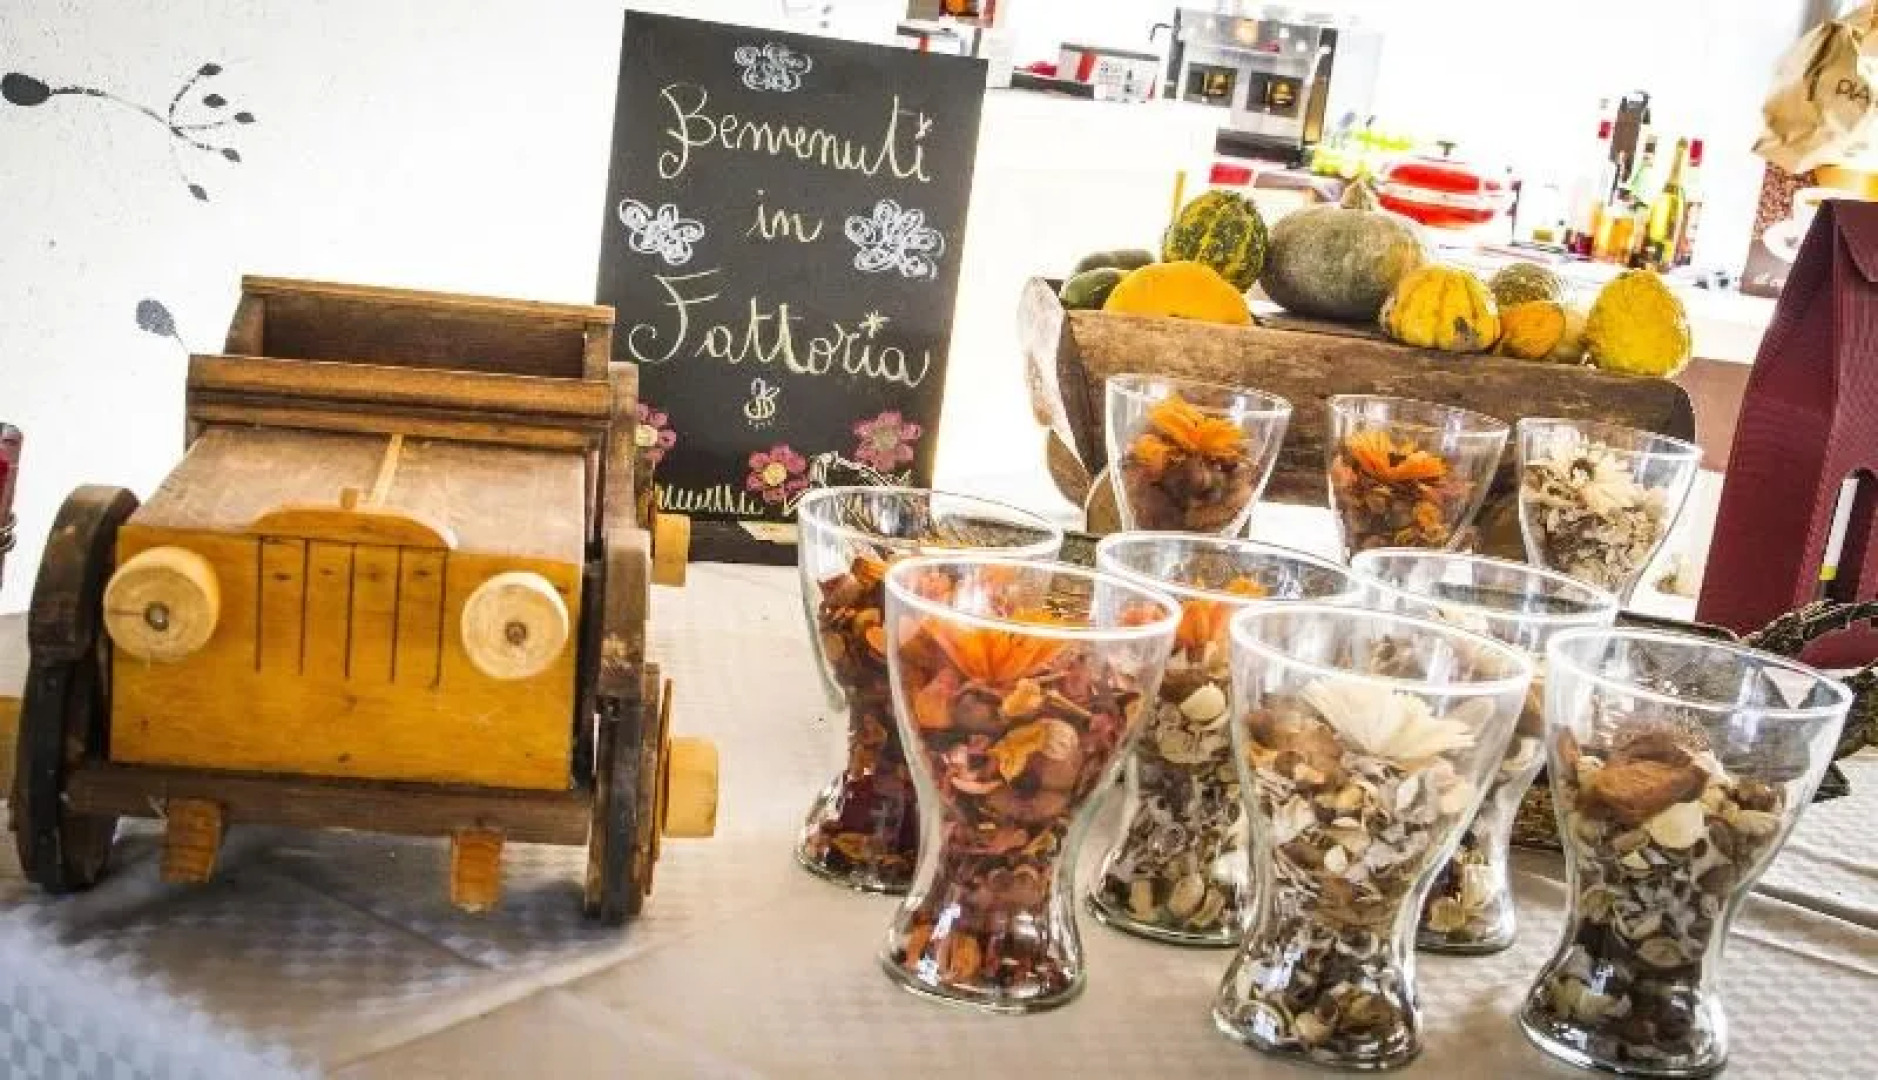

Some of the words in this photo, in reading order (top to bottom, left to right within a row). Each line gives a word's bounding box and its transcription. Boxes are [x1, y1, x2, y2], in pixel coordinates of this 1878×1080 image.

[659, 82, 932, 180] Benvenuti
[745, 190, 823, 242] in
[628, 269, 931, 387] Fattoria
